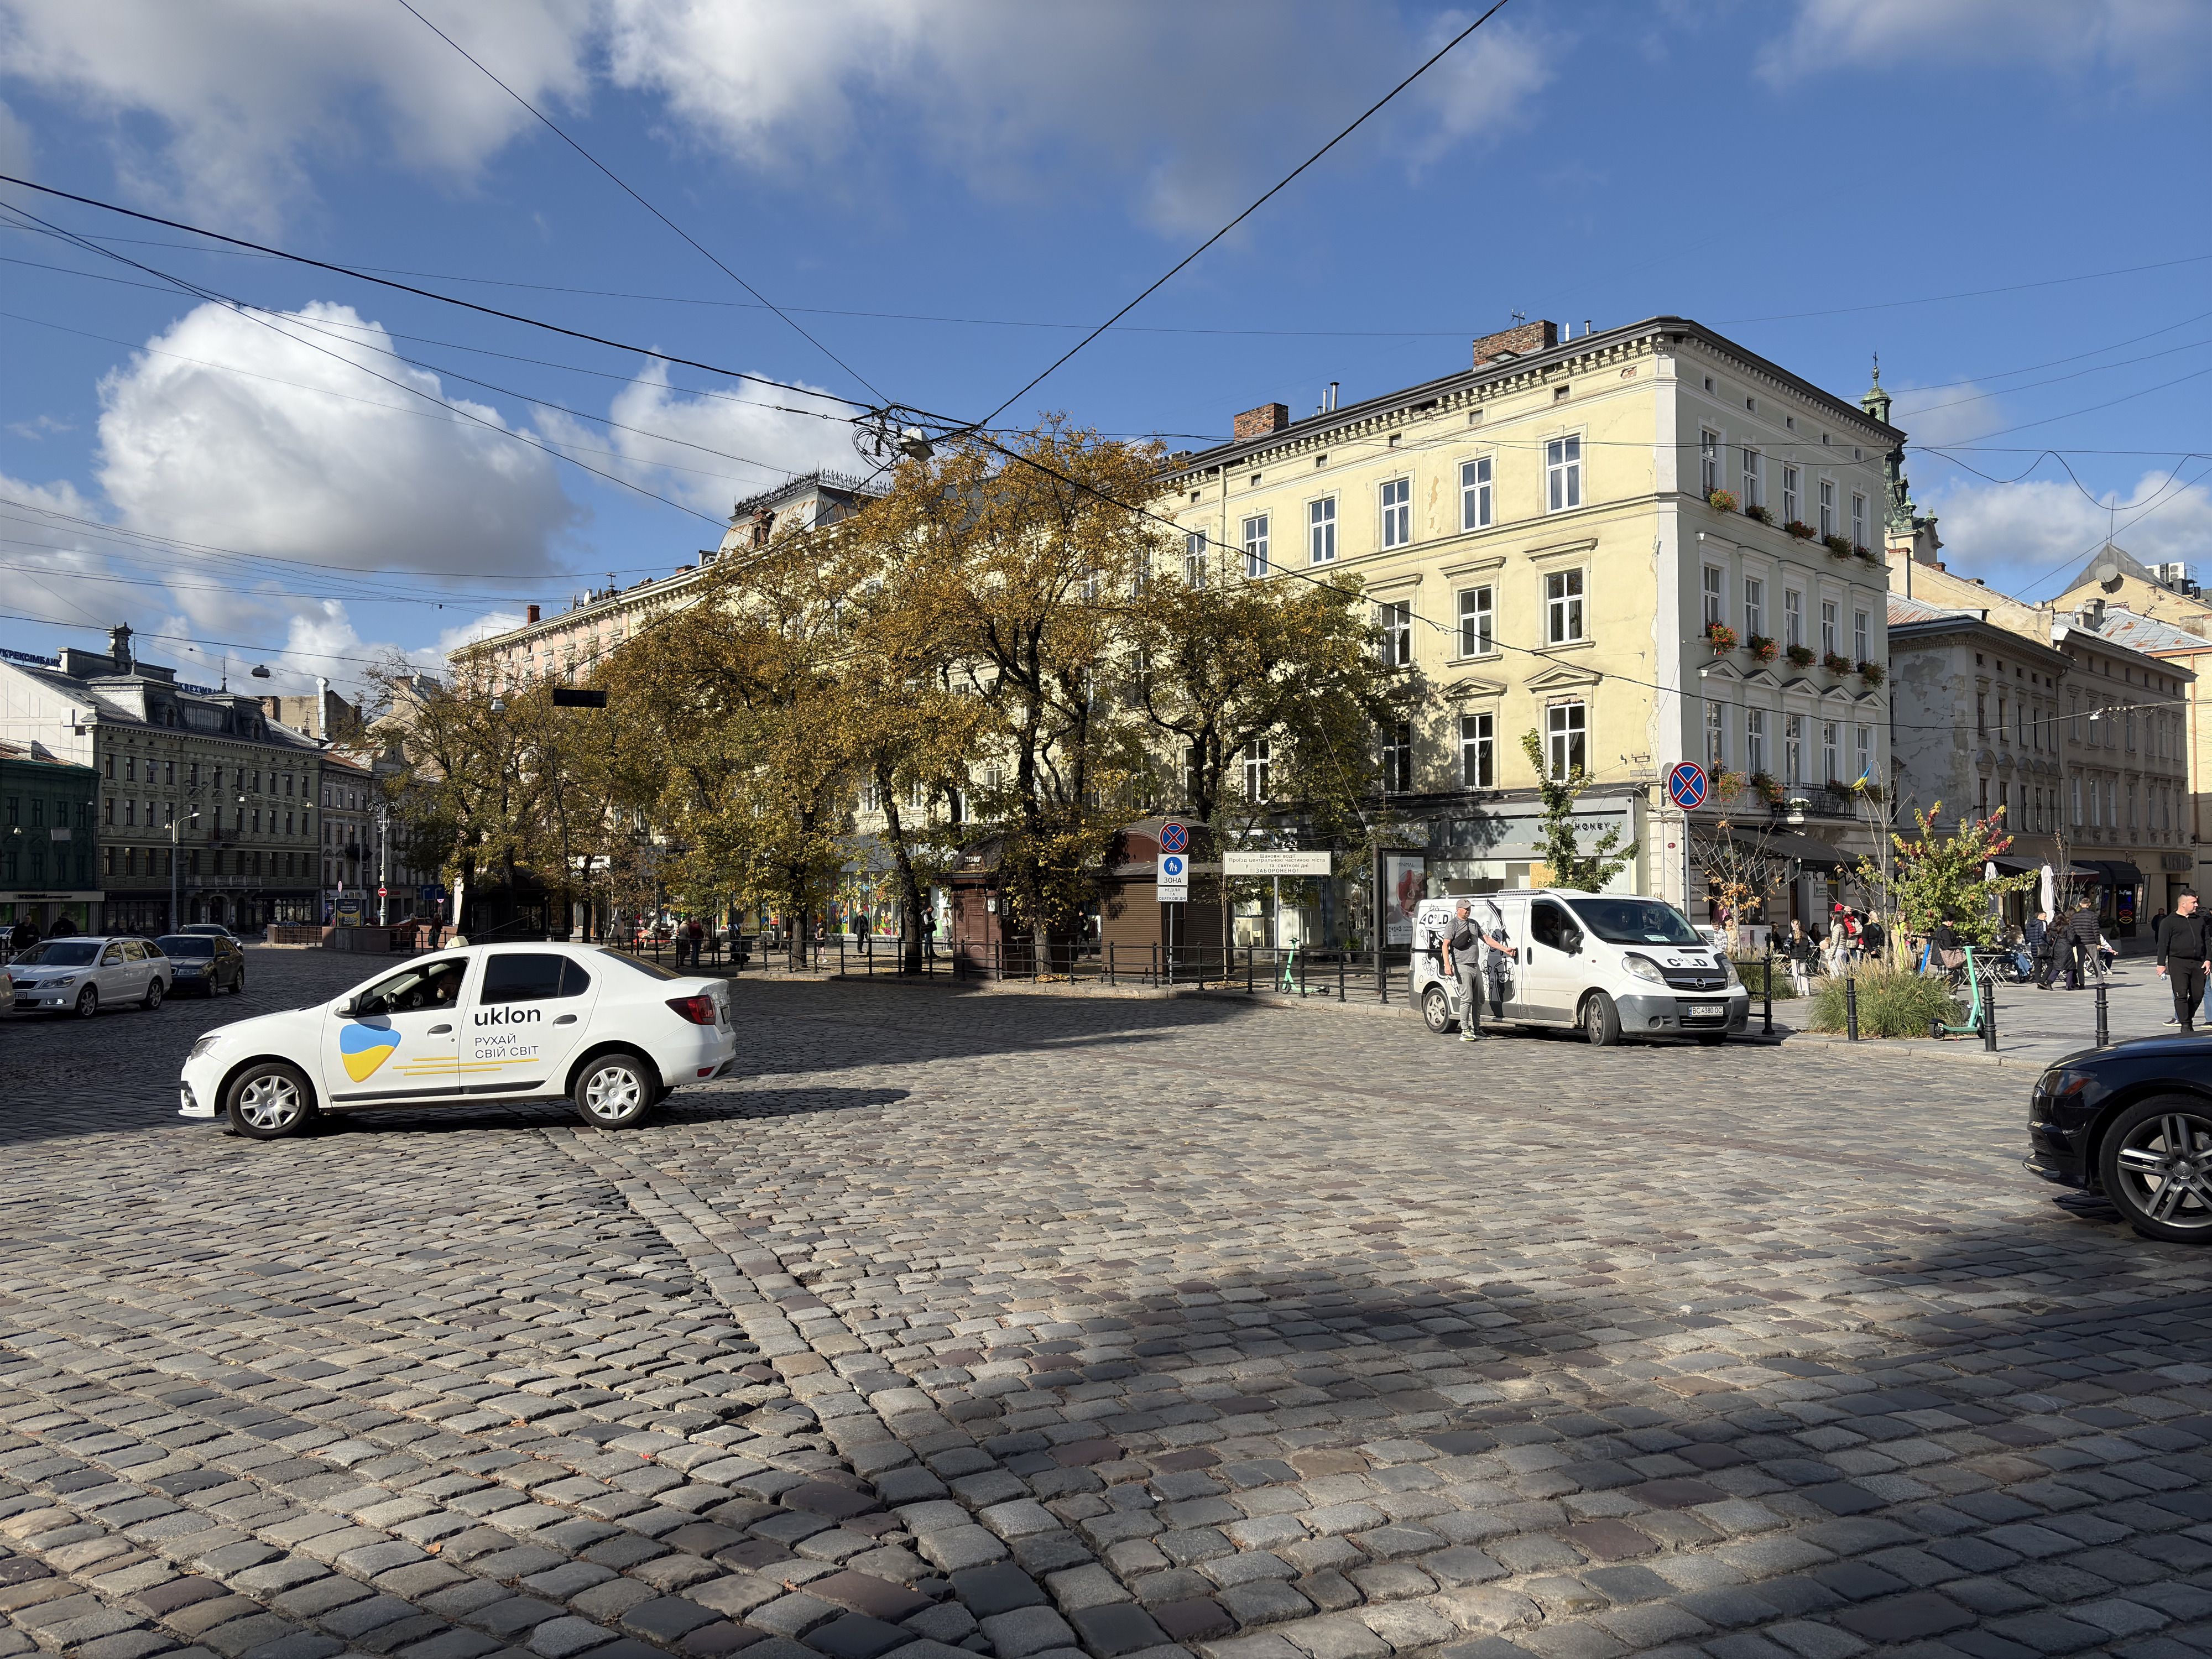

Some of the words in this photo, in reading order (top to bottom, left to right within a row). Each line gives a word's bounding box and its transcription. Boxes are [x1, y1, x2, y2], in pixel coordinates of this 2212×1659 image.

[1575, 822, 1610, 831] HONEY
[474, 1006, 541, 1026] uklon
[475, 1032, 516, 1046] РУХАЙ
[475, 1046, 505, 1058] СВІЙ
[510, 1046, 539, 1056] СВІТ
